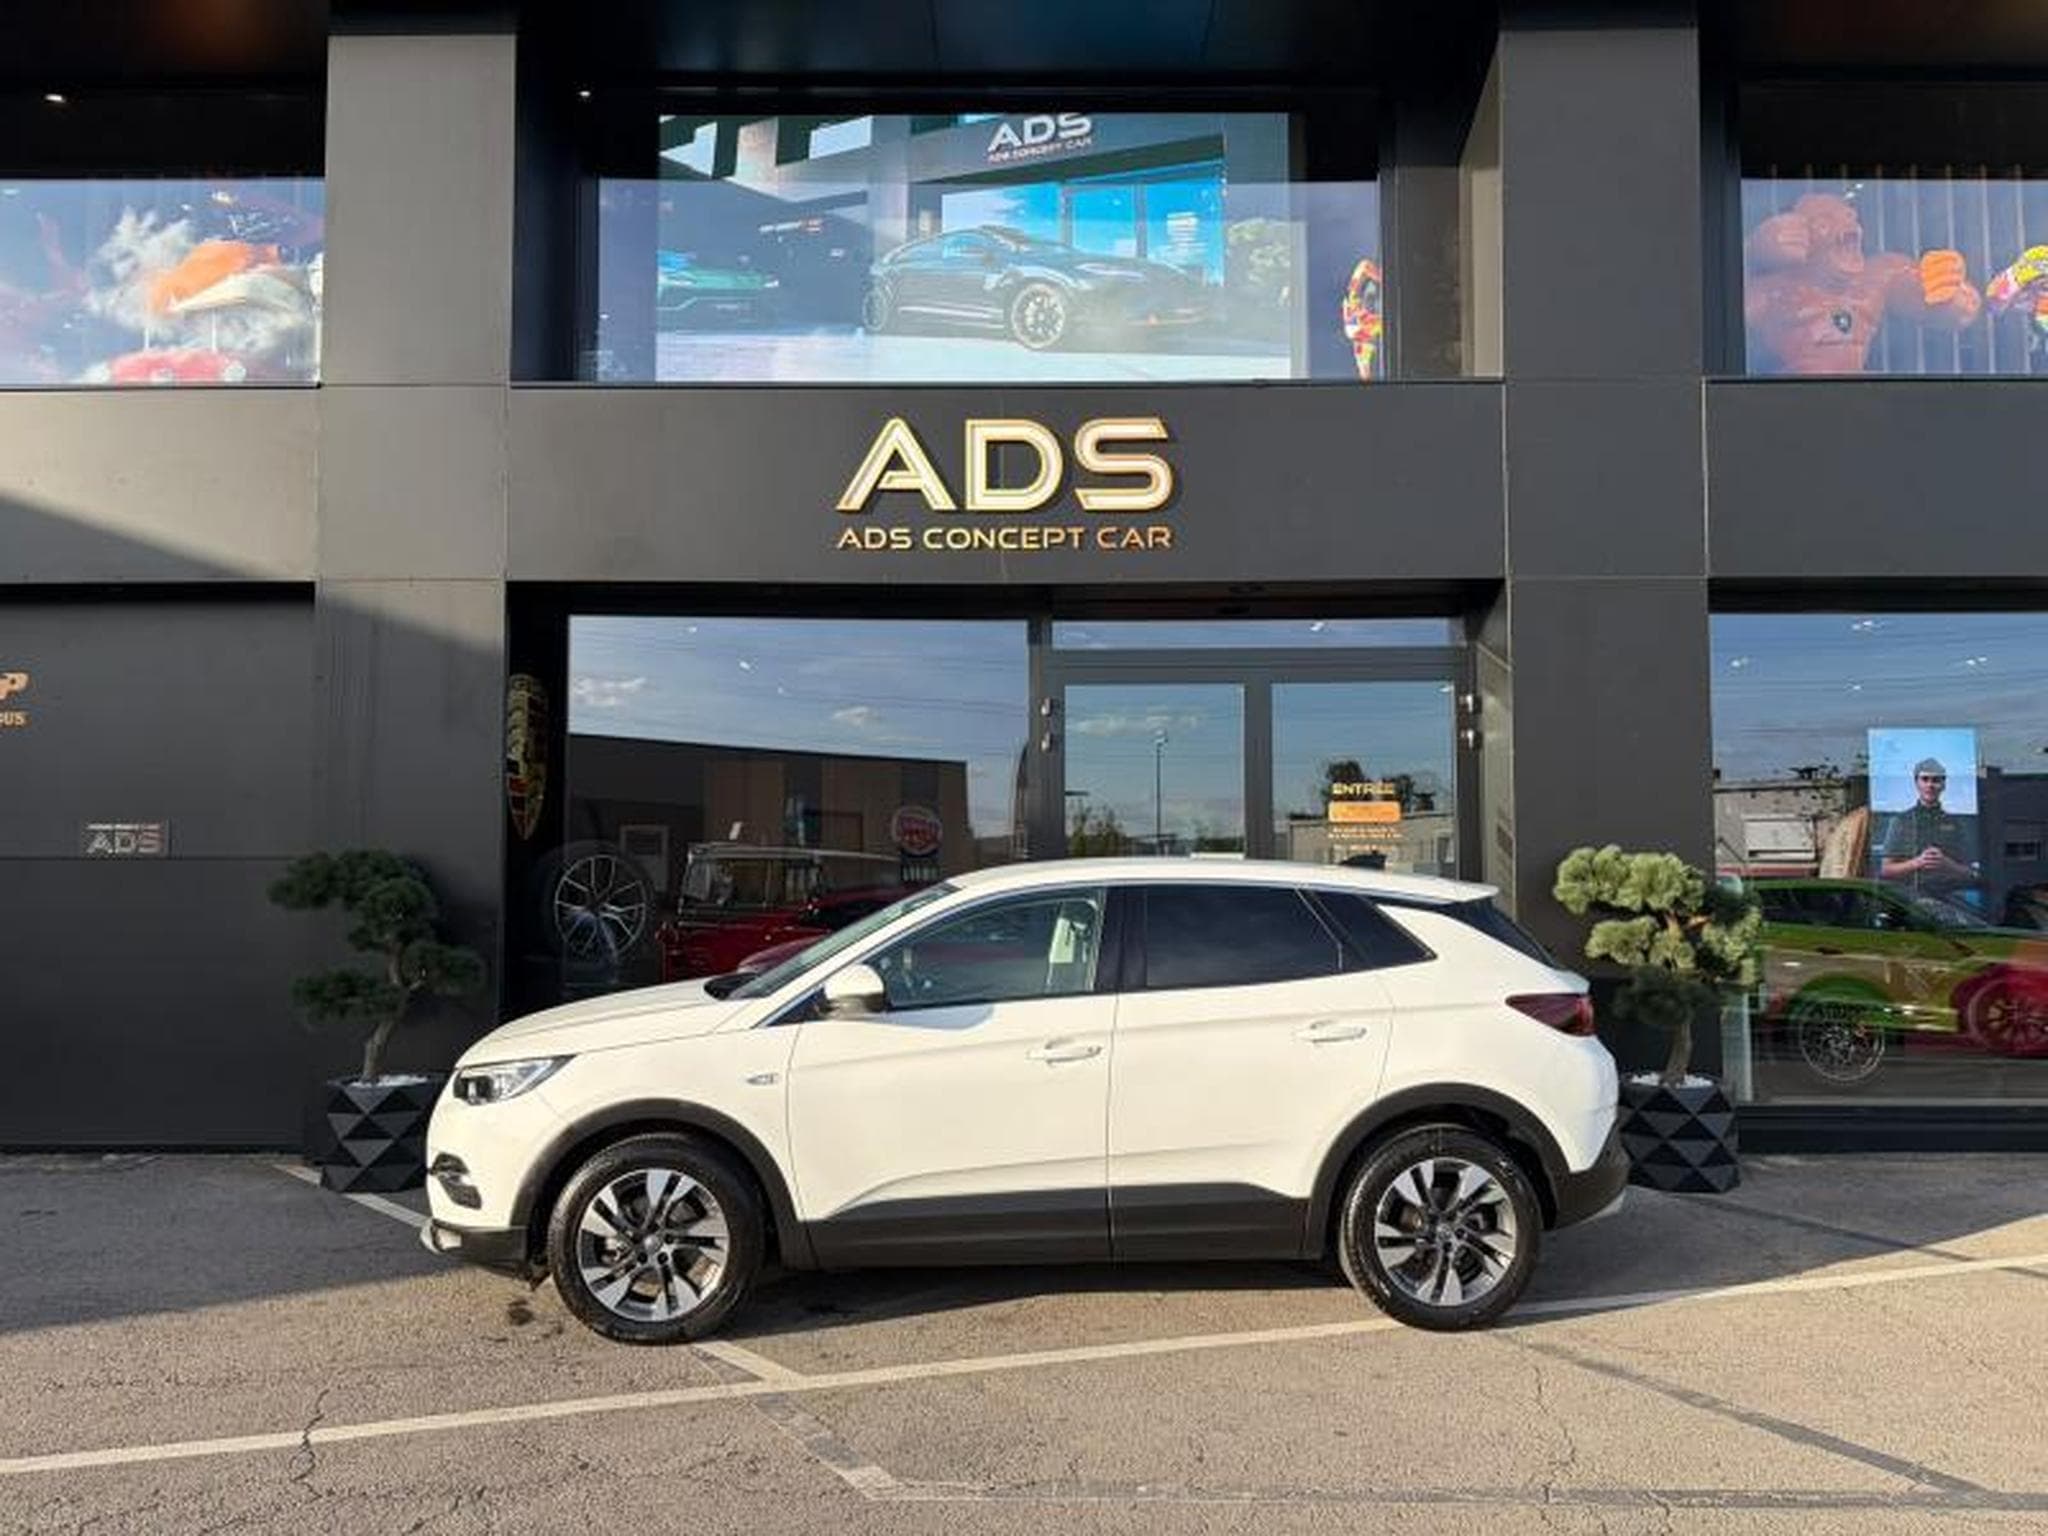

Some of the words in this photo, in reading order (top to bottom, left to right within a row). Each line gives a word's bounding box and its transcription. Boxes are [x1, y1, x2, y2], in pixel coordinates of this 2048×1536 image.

[987, 112, 1092, 152] ADS
[835, 417, 1174, 511] ADS
[837, 526, 912, 550] ADS
[923, 526, 1085, 551] CONCEPT
[1096, 526, 1172, 549] CAR
[86, 824, 163, 854] ADS
